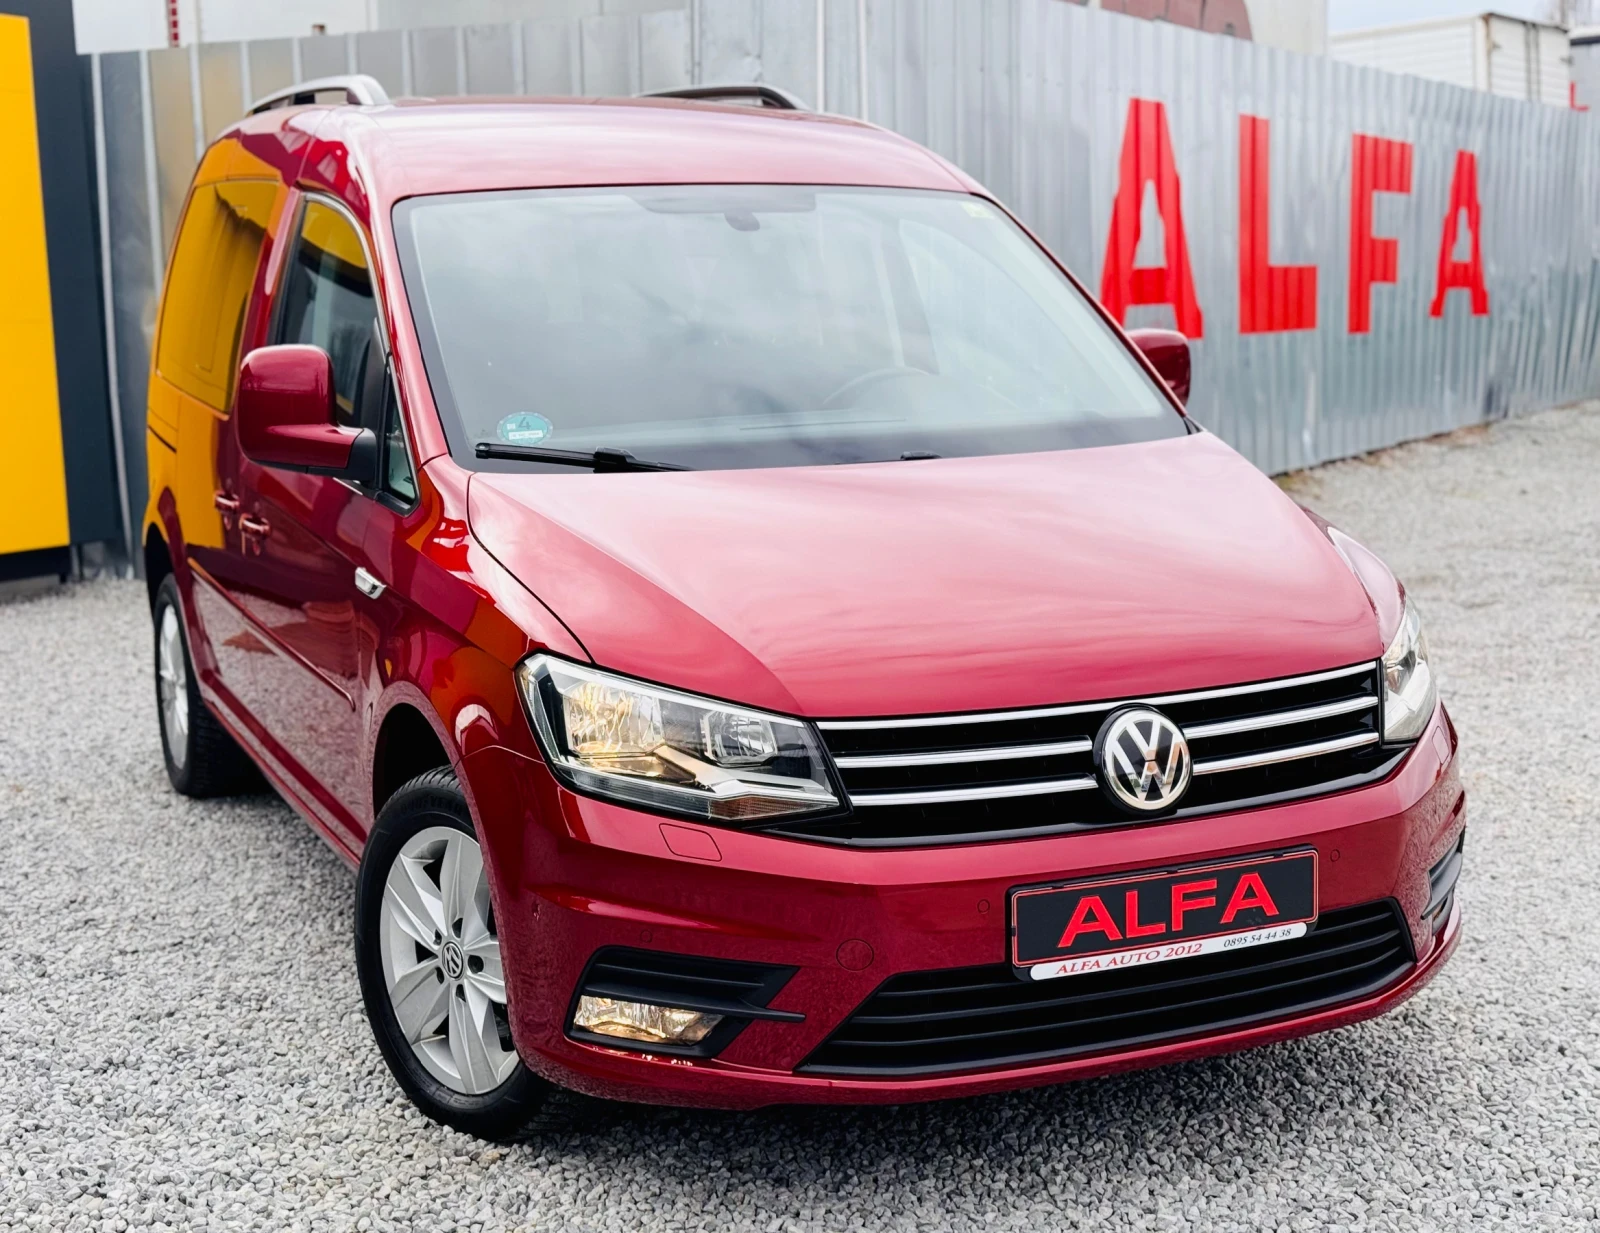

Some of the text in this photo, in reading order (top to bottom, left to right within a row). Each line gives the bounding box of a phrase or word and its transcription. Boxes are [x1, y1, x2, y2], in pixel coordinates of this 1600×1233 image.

[1101, 97, 1490, 339] ALFA
[517, 416, 531, 430] 4
[1102, 708, 1191, 810] VW
[1057, 871, 1280, 948] ALFA
[1055, 943, 1203, 975] ALFA AUTO 2012
[1223, 928, 1292, 948] 0895 54 44 38
